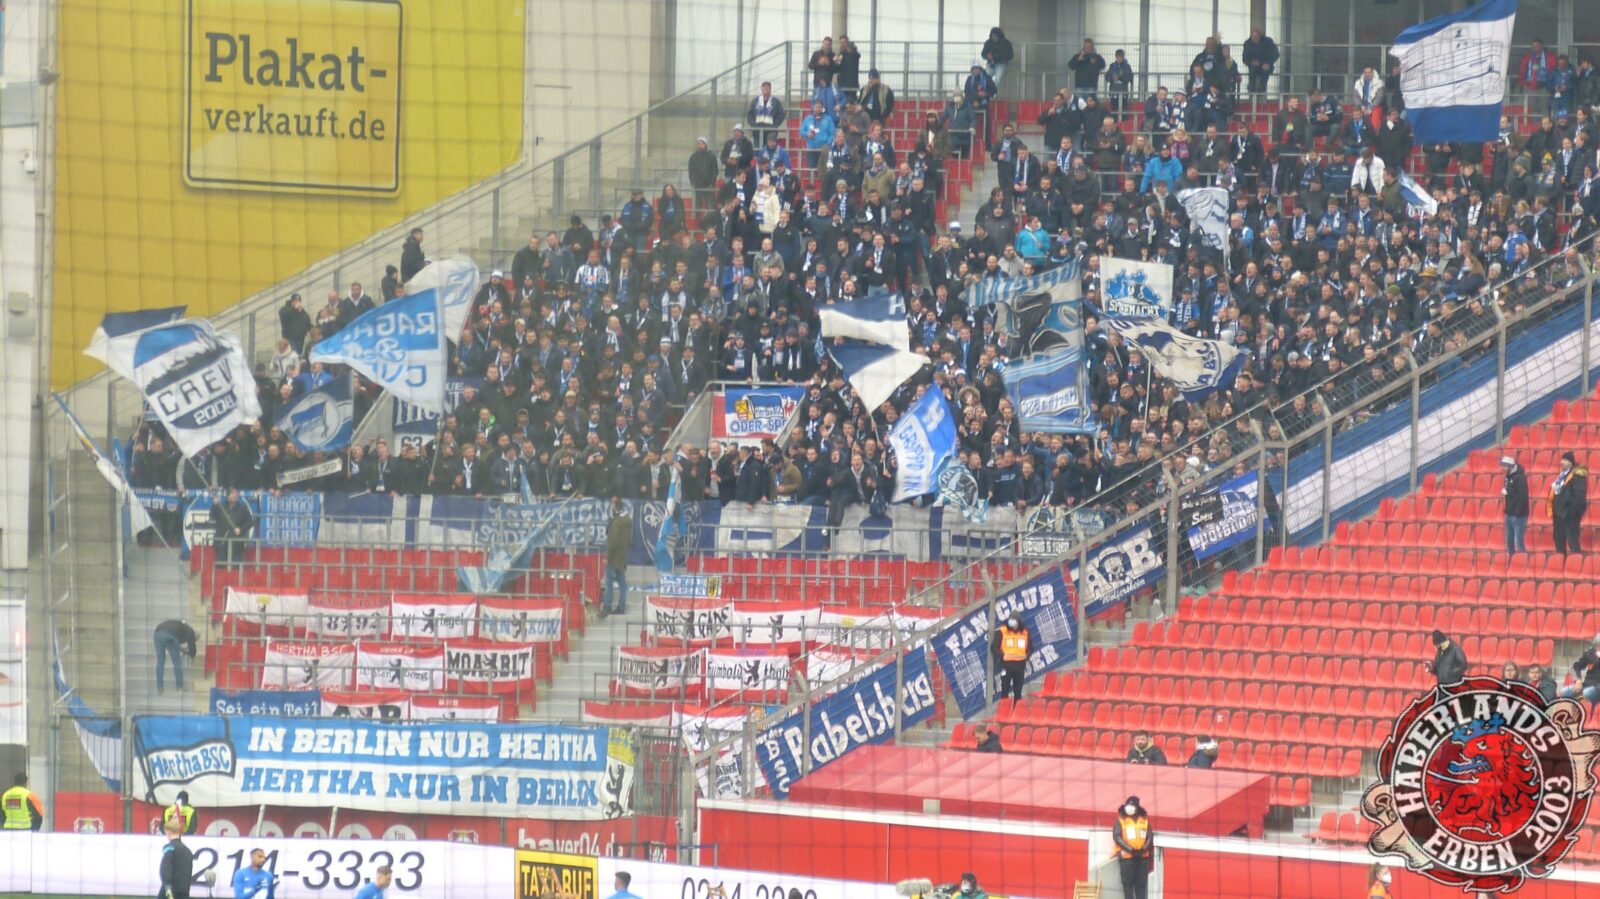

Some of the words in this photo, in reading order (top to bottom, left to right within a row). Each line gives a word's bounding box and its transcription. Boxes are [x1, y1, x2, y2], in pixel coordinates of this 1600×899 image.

[205, 32, 387, 92] Plakat-
[204, 104, 386, 141] verkauft.de
[194, 393, 238, 426] 2008
[945, 611, 990, 657] FAN
[995, 584, 1054, 622] CLUB
[248, 726, 283, 752] IN
[293, 724, 413, 757] BERLIN
[418, 730, 490, 759] NUR
[498, 732, 597, 762] HERTHA
[784, 672, 935, 776] Babelsberg
[240, 766, 376, 795] HERTHA
[386, 773, 460, 799] NUR
[470, 775, 506, 803] IN
[515, 778, 600, 807] BERLIN
